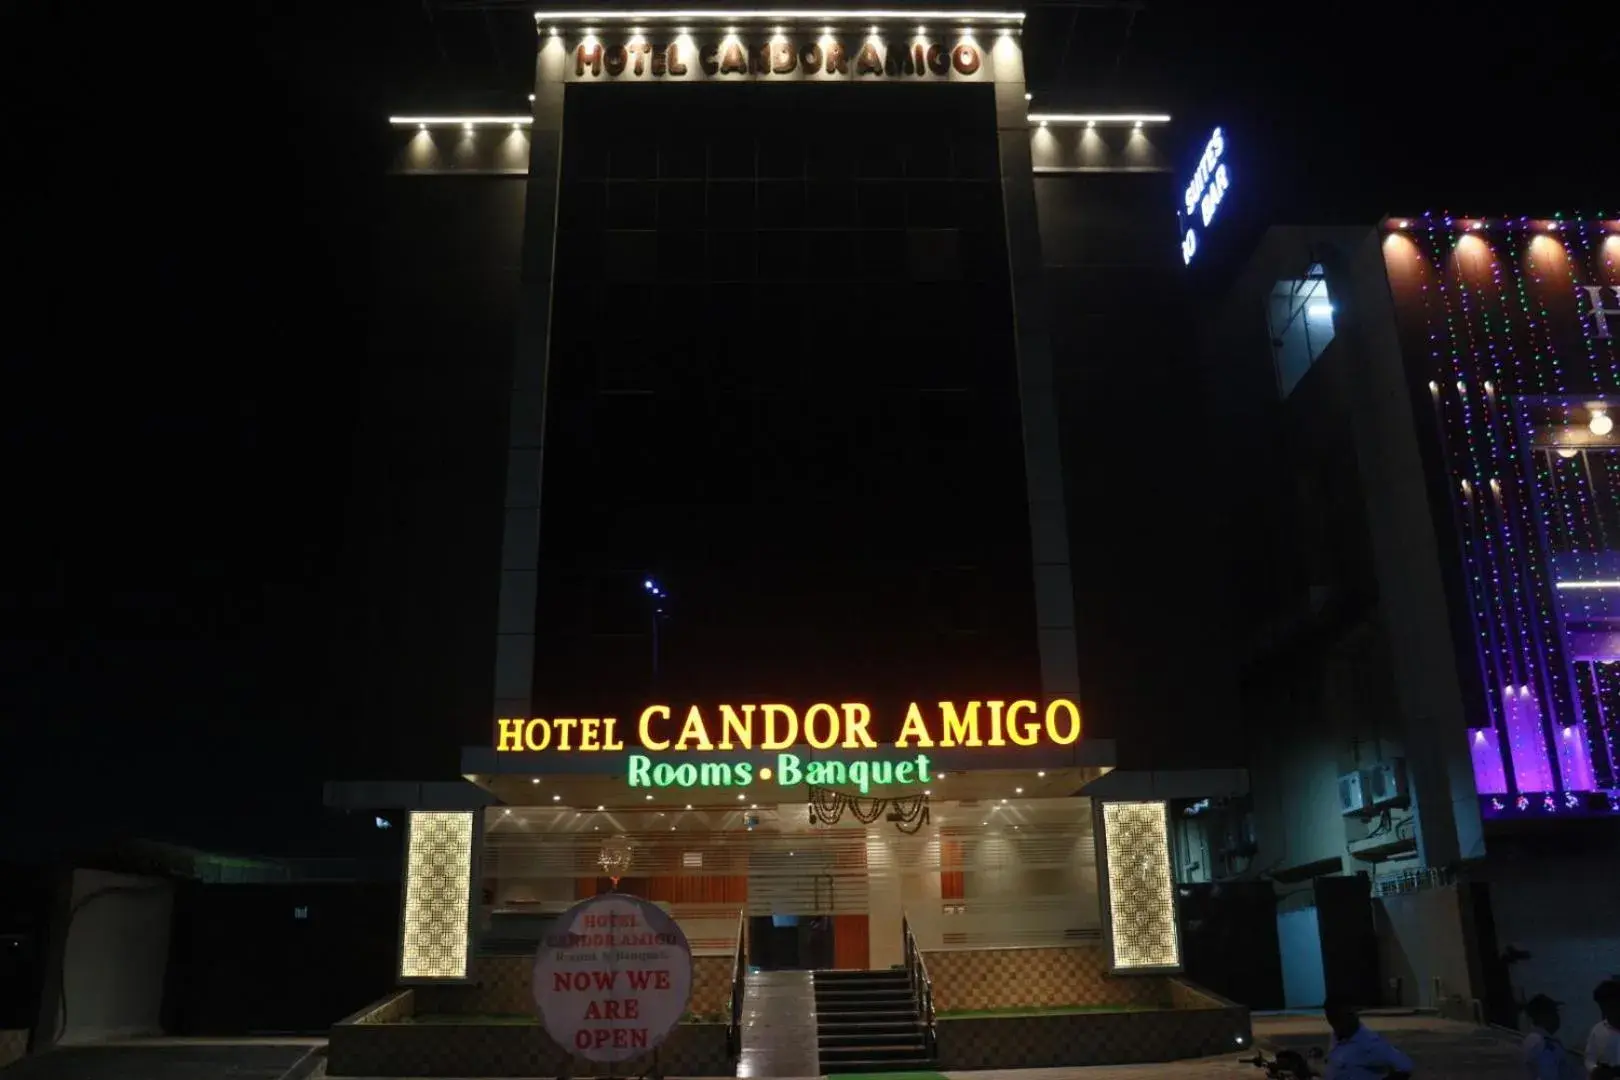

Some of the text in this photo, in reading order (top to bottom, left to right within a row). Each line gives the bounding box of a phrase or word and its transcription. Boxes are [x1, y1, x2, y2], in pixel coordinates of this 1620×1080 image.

[576, 43, 981, 77] HOTEL CANDOR AMIGO
[1201, 163, 1229, 228] BAR
[496, 698, 1083, 753] HOTEL CANDOR AMIGO
[628, 754, 932, 794] Rooms Banquet
[583, 914, 639, 928] HOTEL
[553, 970, 670, 992] NOW WE
[584, 999, 639, 1020] ARE
[575, 1028, 649, 1049] OPEN
